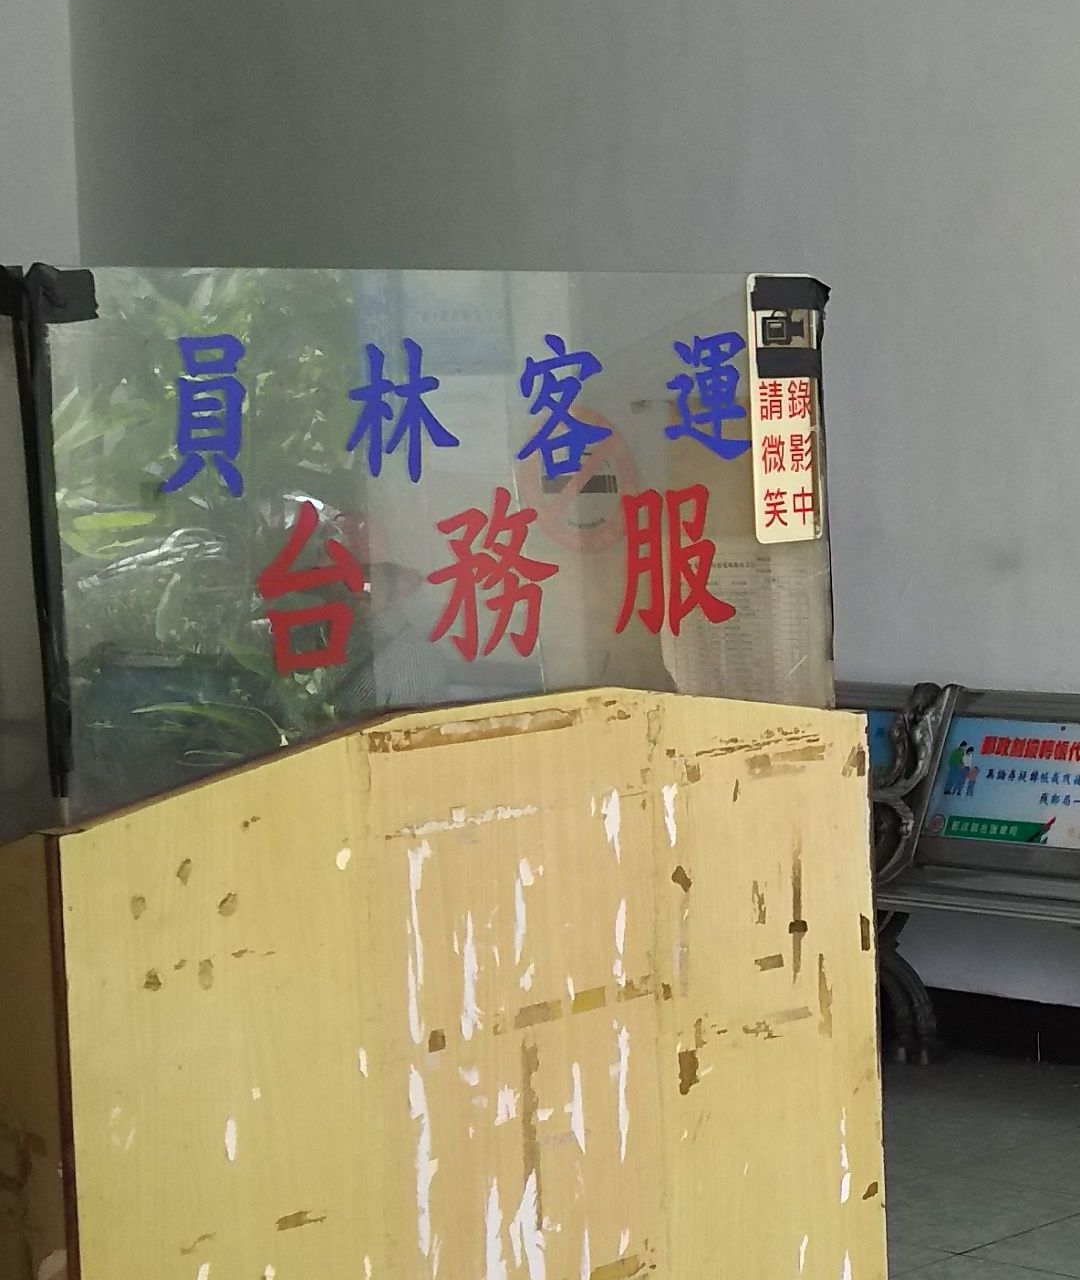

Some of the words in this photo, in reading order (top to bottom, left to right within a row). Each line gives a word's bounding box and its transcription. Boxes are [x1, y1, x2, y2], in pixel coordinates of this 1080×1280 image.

[160, 331, 752, 498] 員林客運
[758, 380, 789, 529] 請微笑
[787, 379, 816, 526] 錄影中
